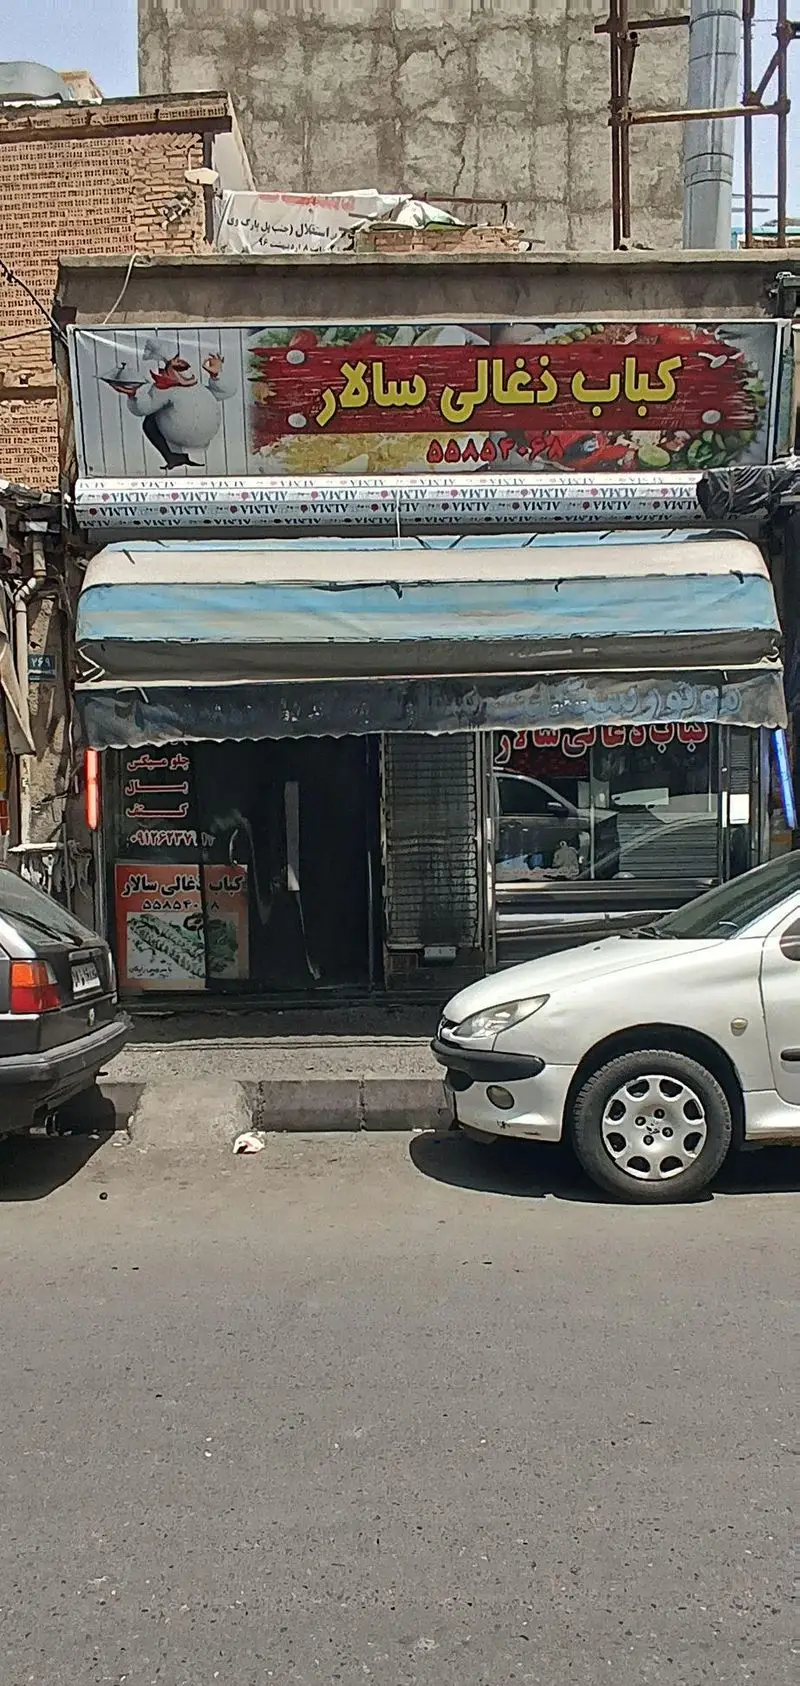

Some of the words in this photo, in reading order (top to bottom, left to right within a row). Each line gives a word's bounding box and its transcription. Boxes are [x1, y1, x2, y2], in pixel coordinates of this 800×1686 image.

[315, 360, 427, 427] سالار
[439, 354, 559, 425] ذغالی
[570, 354, 683, 417] کباب
[425, 437, 565, 465] ۵۵۸۵۴۰۶۸
[124, 779, 189, 796] بال
[121, 873, 158, 898] سالار
[208, 875, 244, 896] کباب
[142, 899, 221, 911] ۵۵۸۵۴۰۸
